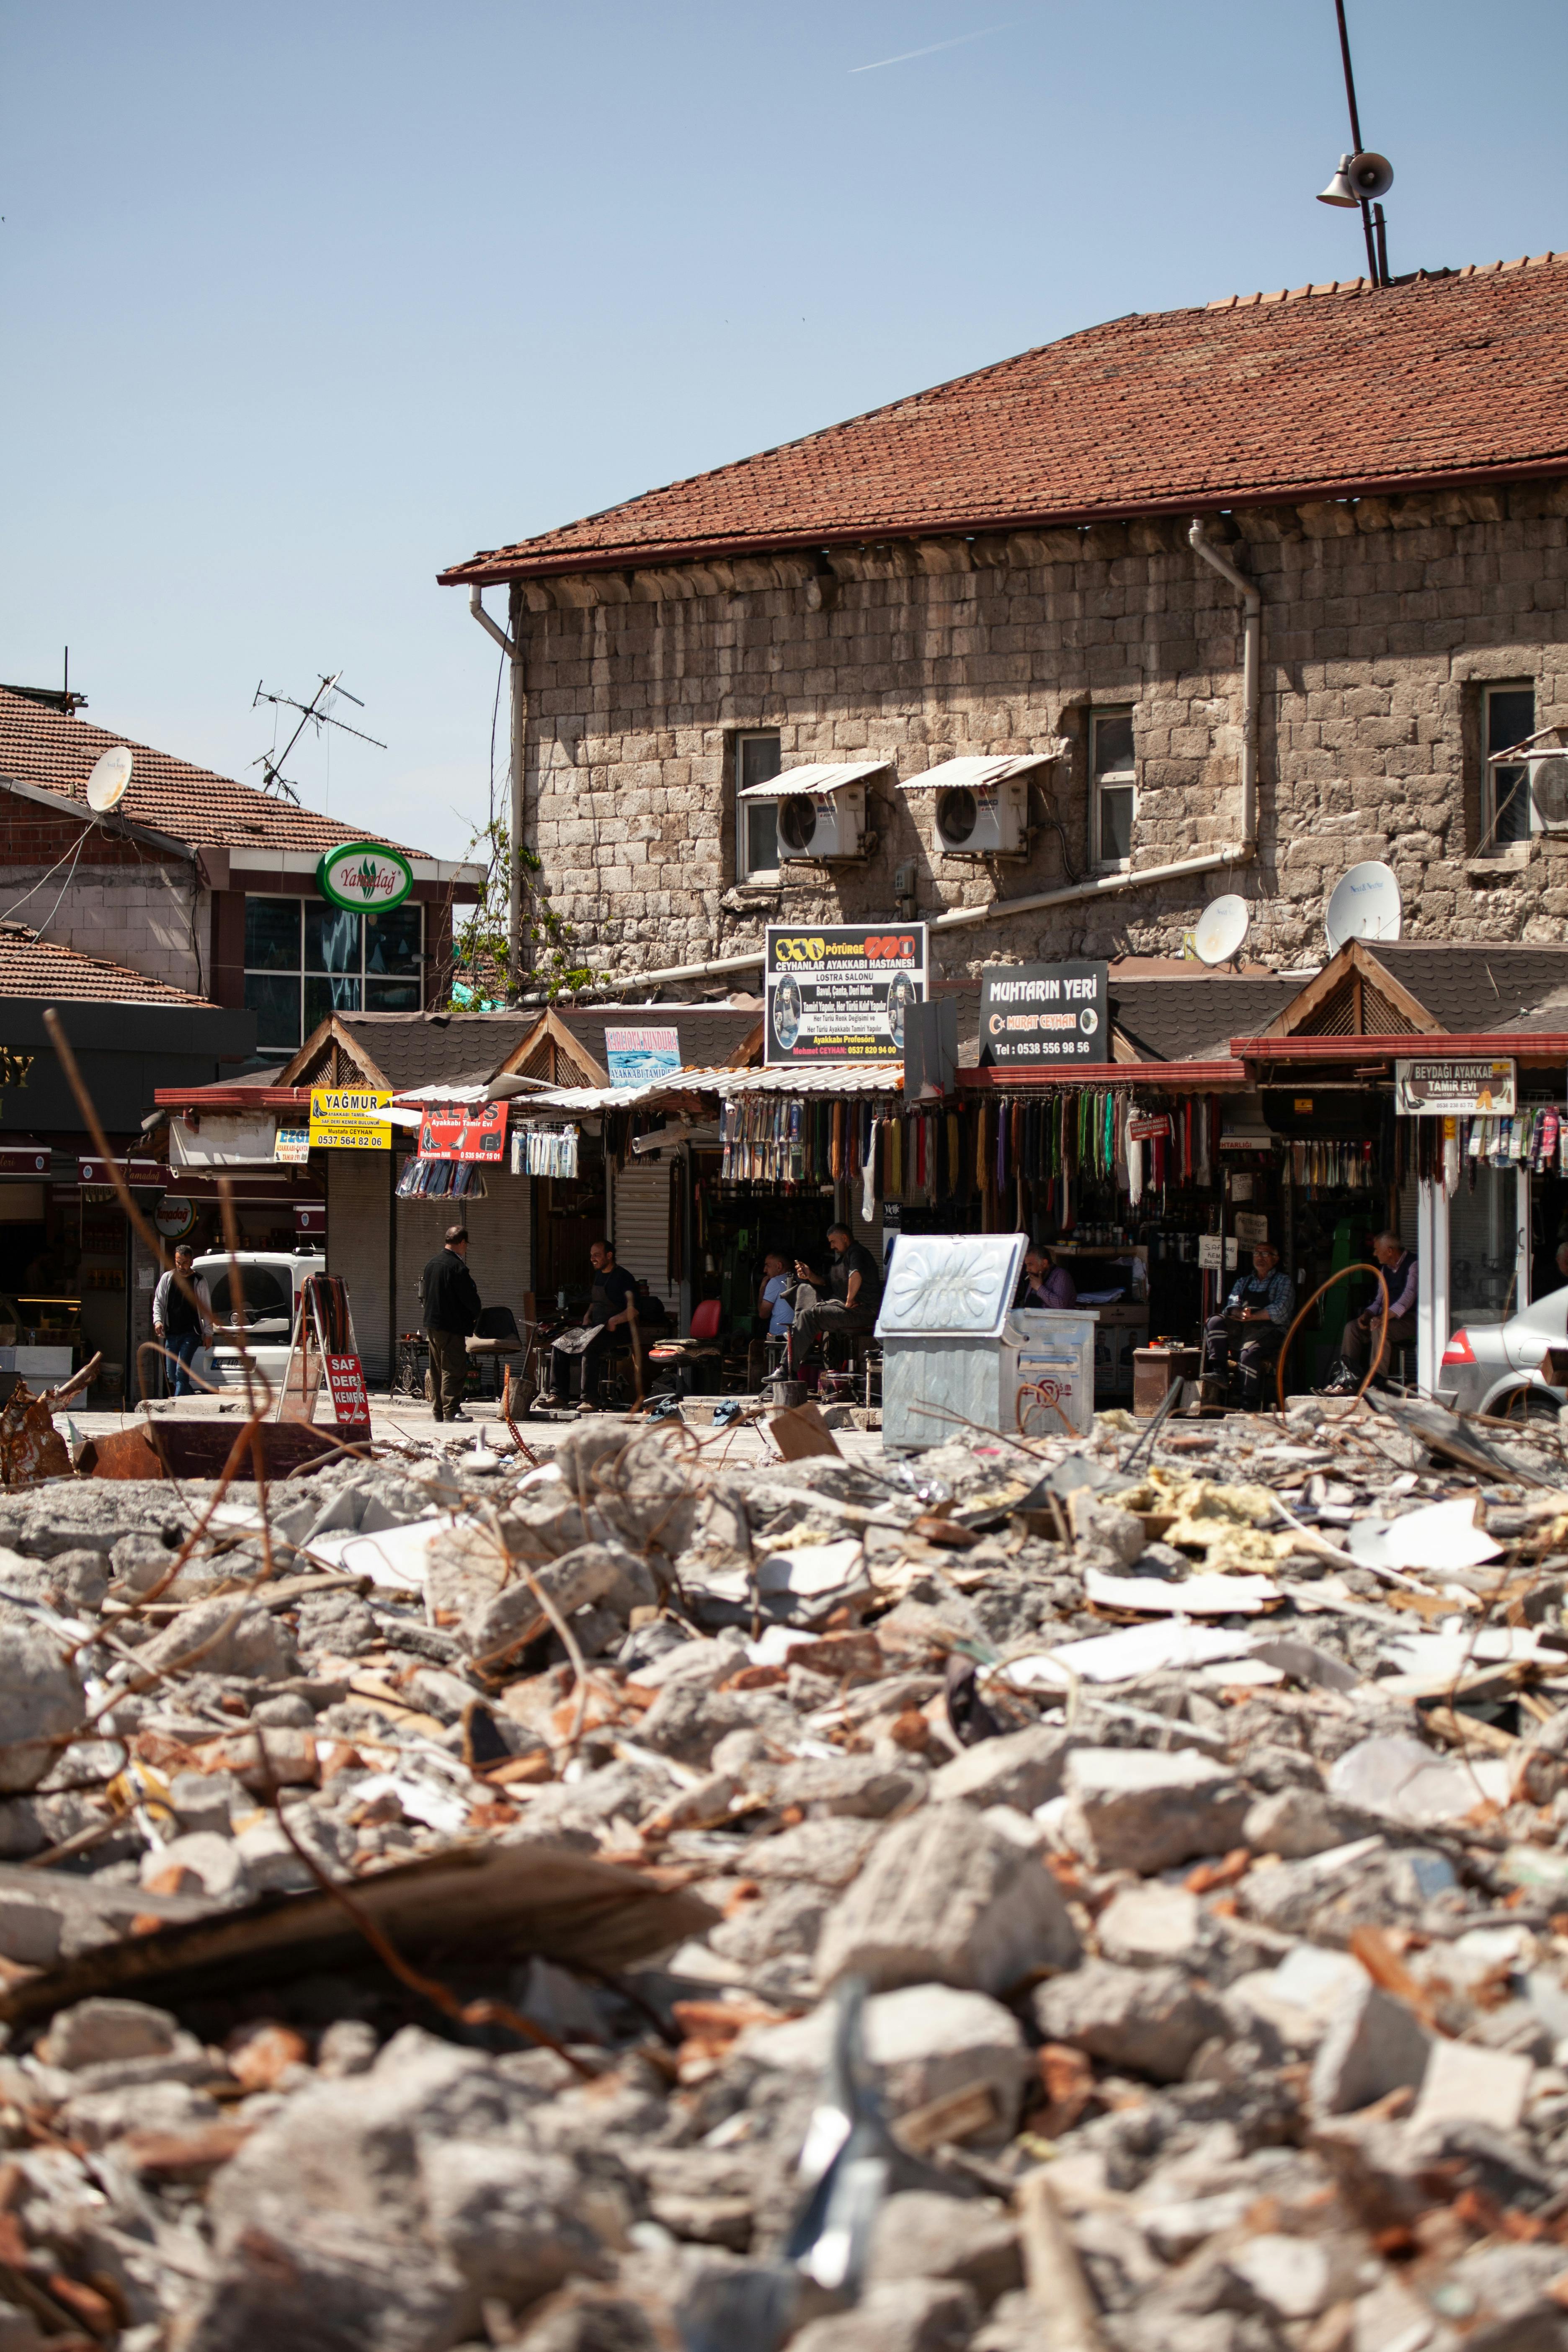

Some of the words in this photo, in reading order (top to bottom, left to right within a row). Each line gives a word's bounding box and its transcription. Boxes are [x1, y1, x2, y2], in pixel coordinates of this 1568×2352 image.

[341, 867, 397, 895] Yamadağ
[825, 943, 864, 955] PÖTÜRGE
[776, 961, 825, 971] CEYHANLAR
[826, 959, 867, 970] AYAKKABI
[869, 956, 915, 968] HASTANESİ
[816, 973, 843, 982] LOSTRA
[816, 985, 831, 998] Bavul,
[832, 985, 848, 998] Çanta,
[848, 985, 859, 995] Deri
[860, 985, 873, 995] Mont
[990, 980, 1060, 1002] MUHTARIN
[1063, 974, 1097, 1000] YERİ
[803, 1001, 818, 1012] Tamiri
[837, 1001, 846, 1011] Her
[846, 1000, 858, 1011] Türlü
[870, 1000, 887, 1013] Yapılır
[848, 1014, 869, 1023] Değişimi
[1006, 1014, 1039, 1031] MURAT
[1039, 1013, 1076, 1030] CEYHAN
[606, 1031, 642, 1050] KARLIOVA
[642, 1031, 678, 1050] KUNDURA
[813, 1036, 842, 1045] Ayakkabı
[843, 1035, 875, 1043] Profesörü
[995, 1044, 1010, 1055] Tel
[1017, 1042, 1040, 1054] 0538
[1042, 1042, 1060, 1054] 556
[1063, 1042, 1074, 1053] 98
[1077, 1041, 1090, 1052] 56
[611, 1068, 644, 1078] AYAKKABI
[1415, 1063, 1452, 1079] BEYDAĞI
[325, 1092, 377, 1109] YAĞMUR
[427, 1101, 499, 1120] KLAS
[318, 1135, 338, 1145] 0537
[340, 1136, 356, 1145] 564
[358, 1137, 369, 1145] 82
[371, 1137, 382, 1146] 06
[157, 1206, 188, 1222] Yamadağ
[331, 1359, 355, 1370] SAF
[331, 1372, 361, 1387] DERİ
